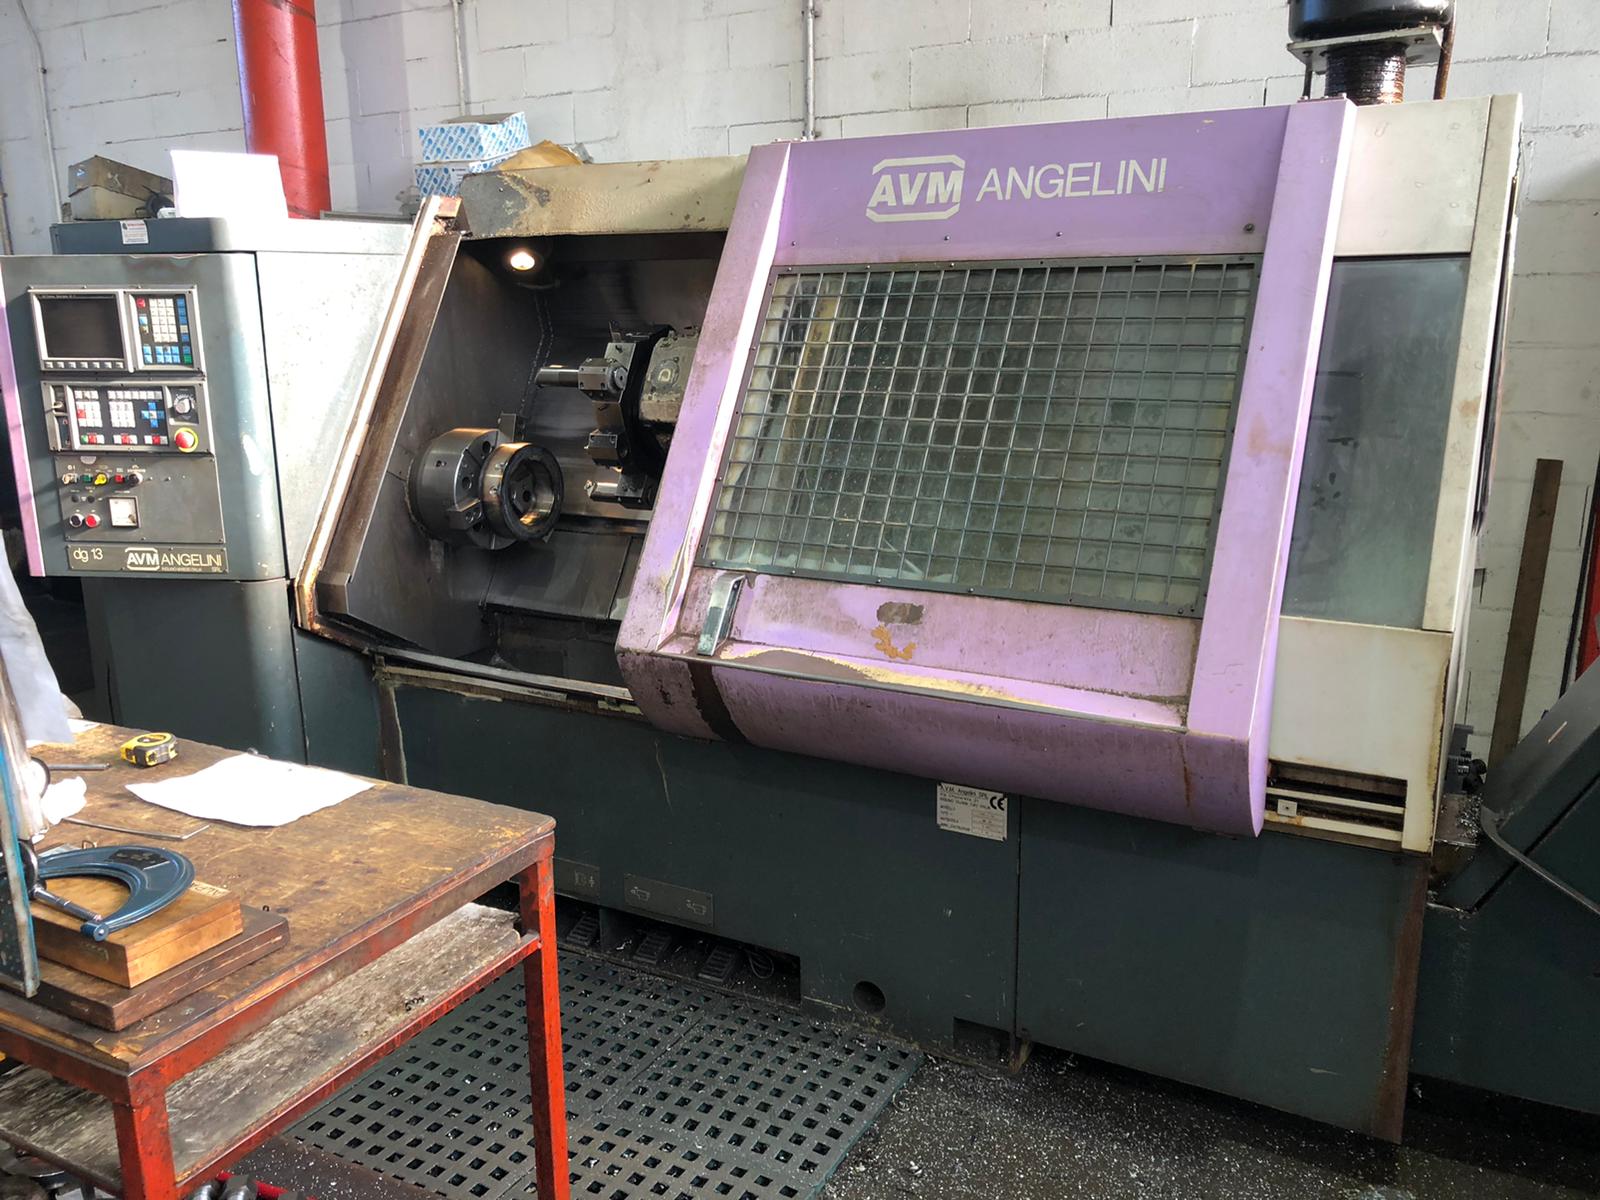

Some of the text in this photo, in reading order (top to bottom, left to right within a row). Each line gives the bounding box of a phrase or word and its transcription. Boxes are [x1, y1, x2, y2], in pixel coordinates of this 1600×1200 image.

[867, 158, 1168, 208] AVM ANGELINI
[73, 547, 104, 563] dg 13
[127, 552, 222, 567] AVM ANGELINI
